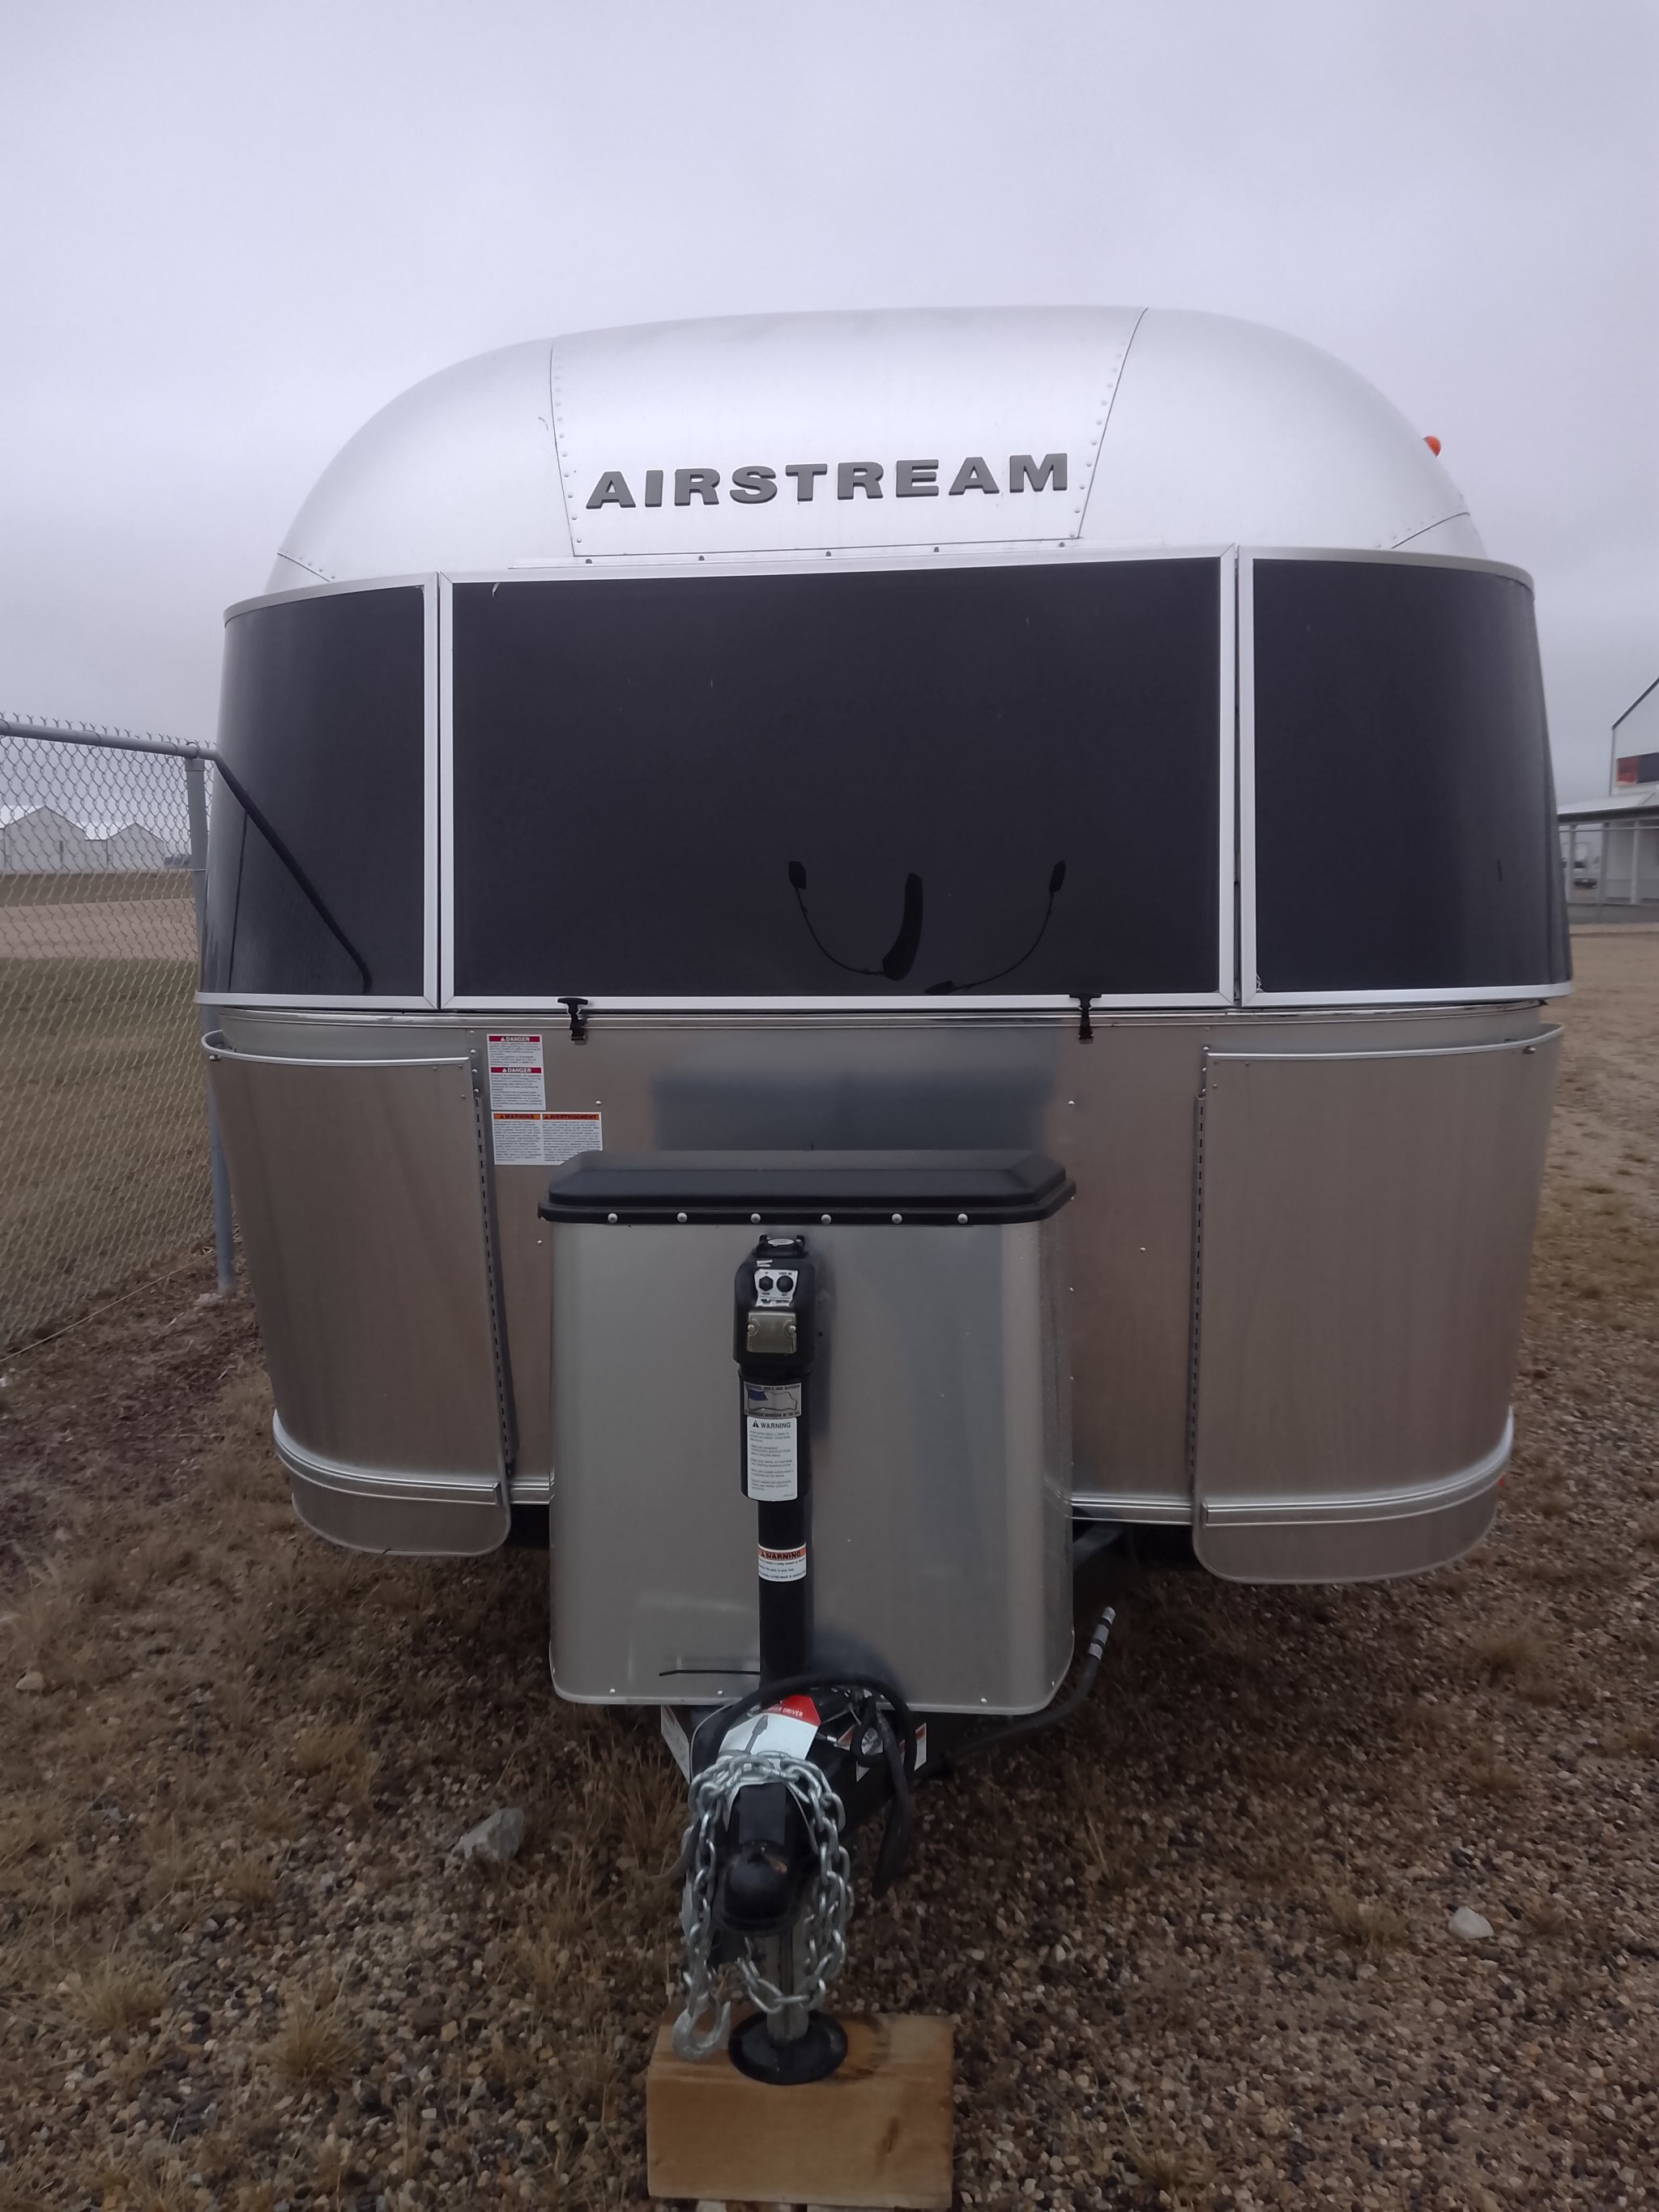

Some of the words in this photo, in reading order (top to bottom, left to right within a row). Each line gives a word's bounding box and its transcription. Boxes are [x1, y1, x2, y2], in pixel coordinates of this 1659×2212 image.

[586, 453, 1068, 509] AIRSTREAM
[760, 1421, 791, 1430] WARNING
[766, 1551, 801, 1560] WARNING
[782, 1707, 804, 1717] DRIVER
